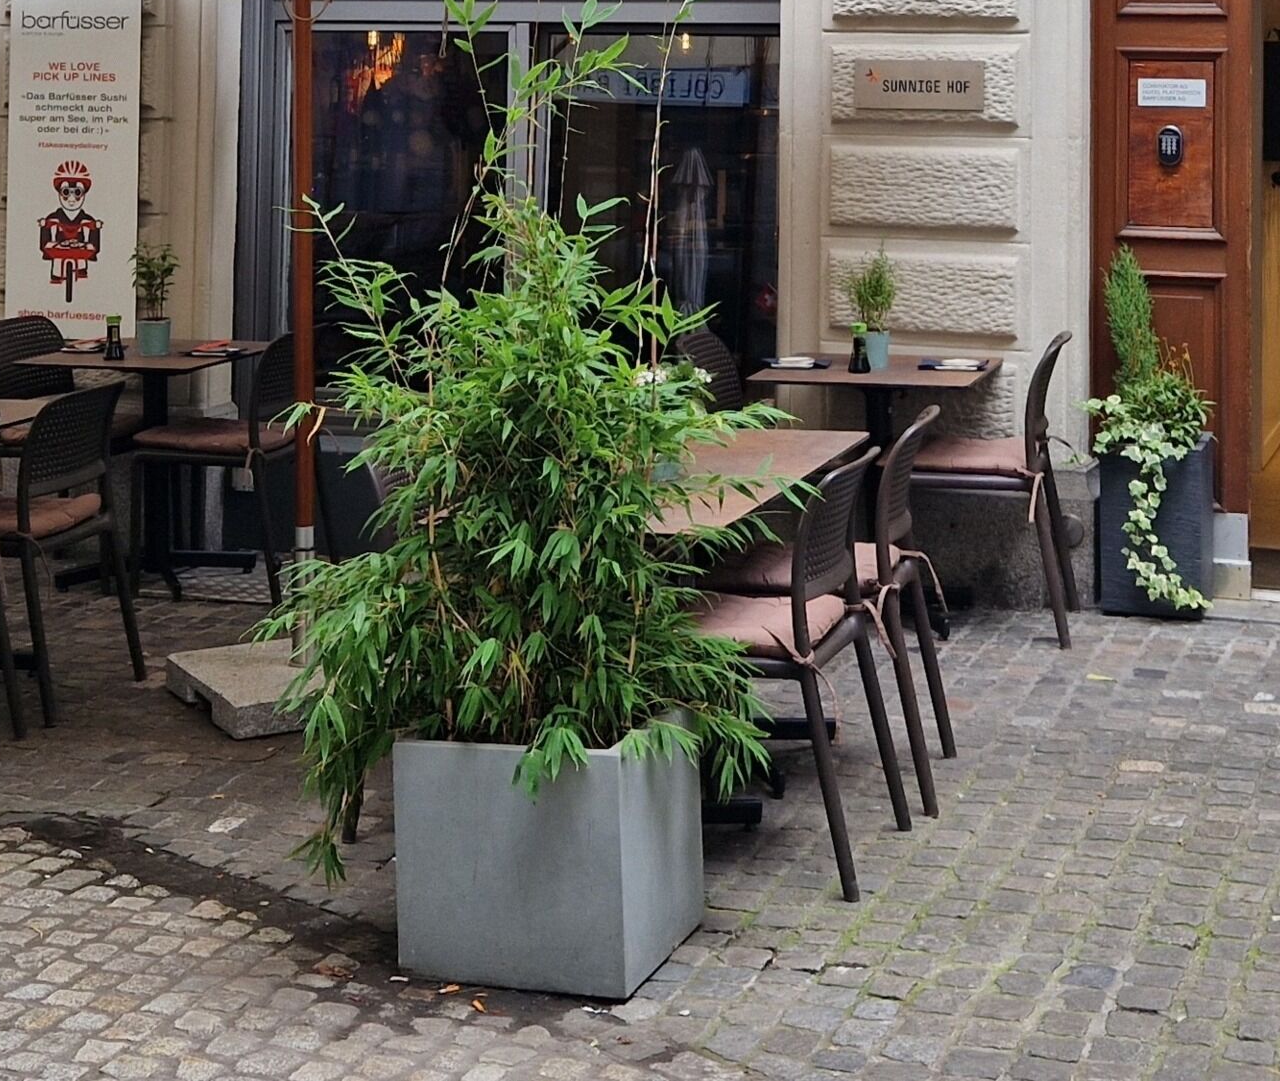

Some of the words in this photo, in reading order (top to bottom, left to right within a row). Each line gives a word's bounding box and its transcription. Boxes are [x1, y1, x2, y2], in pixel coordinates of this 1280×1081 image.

[22, 10, 129, 30] barfüsser
[49, 62, 66, 71] WE
[71, 63, 100, 71] LOVE
[33, 72, 59, 81] PICK
[64, 72, 80, 81] UP
[83, 73, 116, 82] LINES
[882, 79, 941, 93] SUNNIGE
[947, 80, 971, 94] HOF
[48, 92, 96, 101] Barfüsser
[100, 93, 127, 102] Sushi
[35, 104, 84, 112] schmeckt
[88, 104, 112, 113] auch
[92, 115, 104, 123] im
[107, 116, 128, 124] Park
[37, 125, 59, 133] oder
[63, 125, 78, 133] bei
